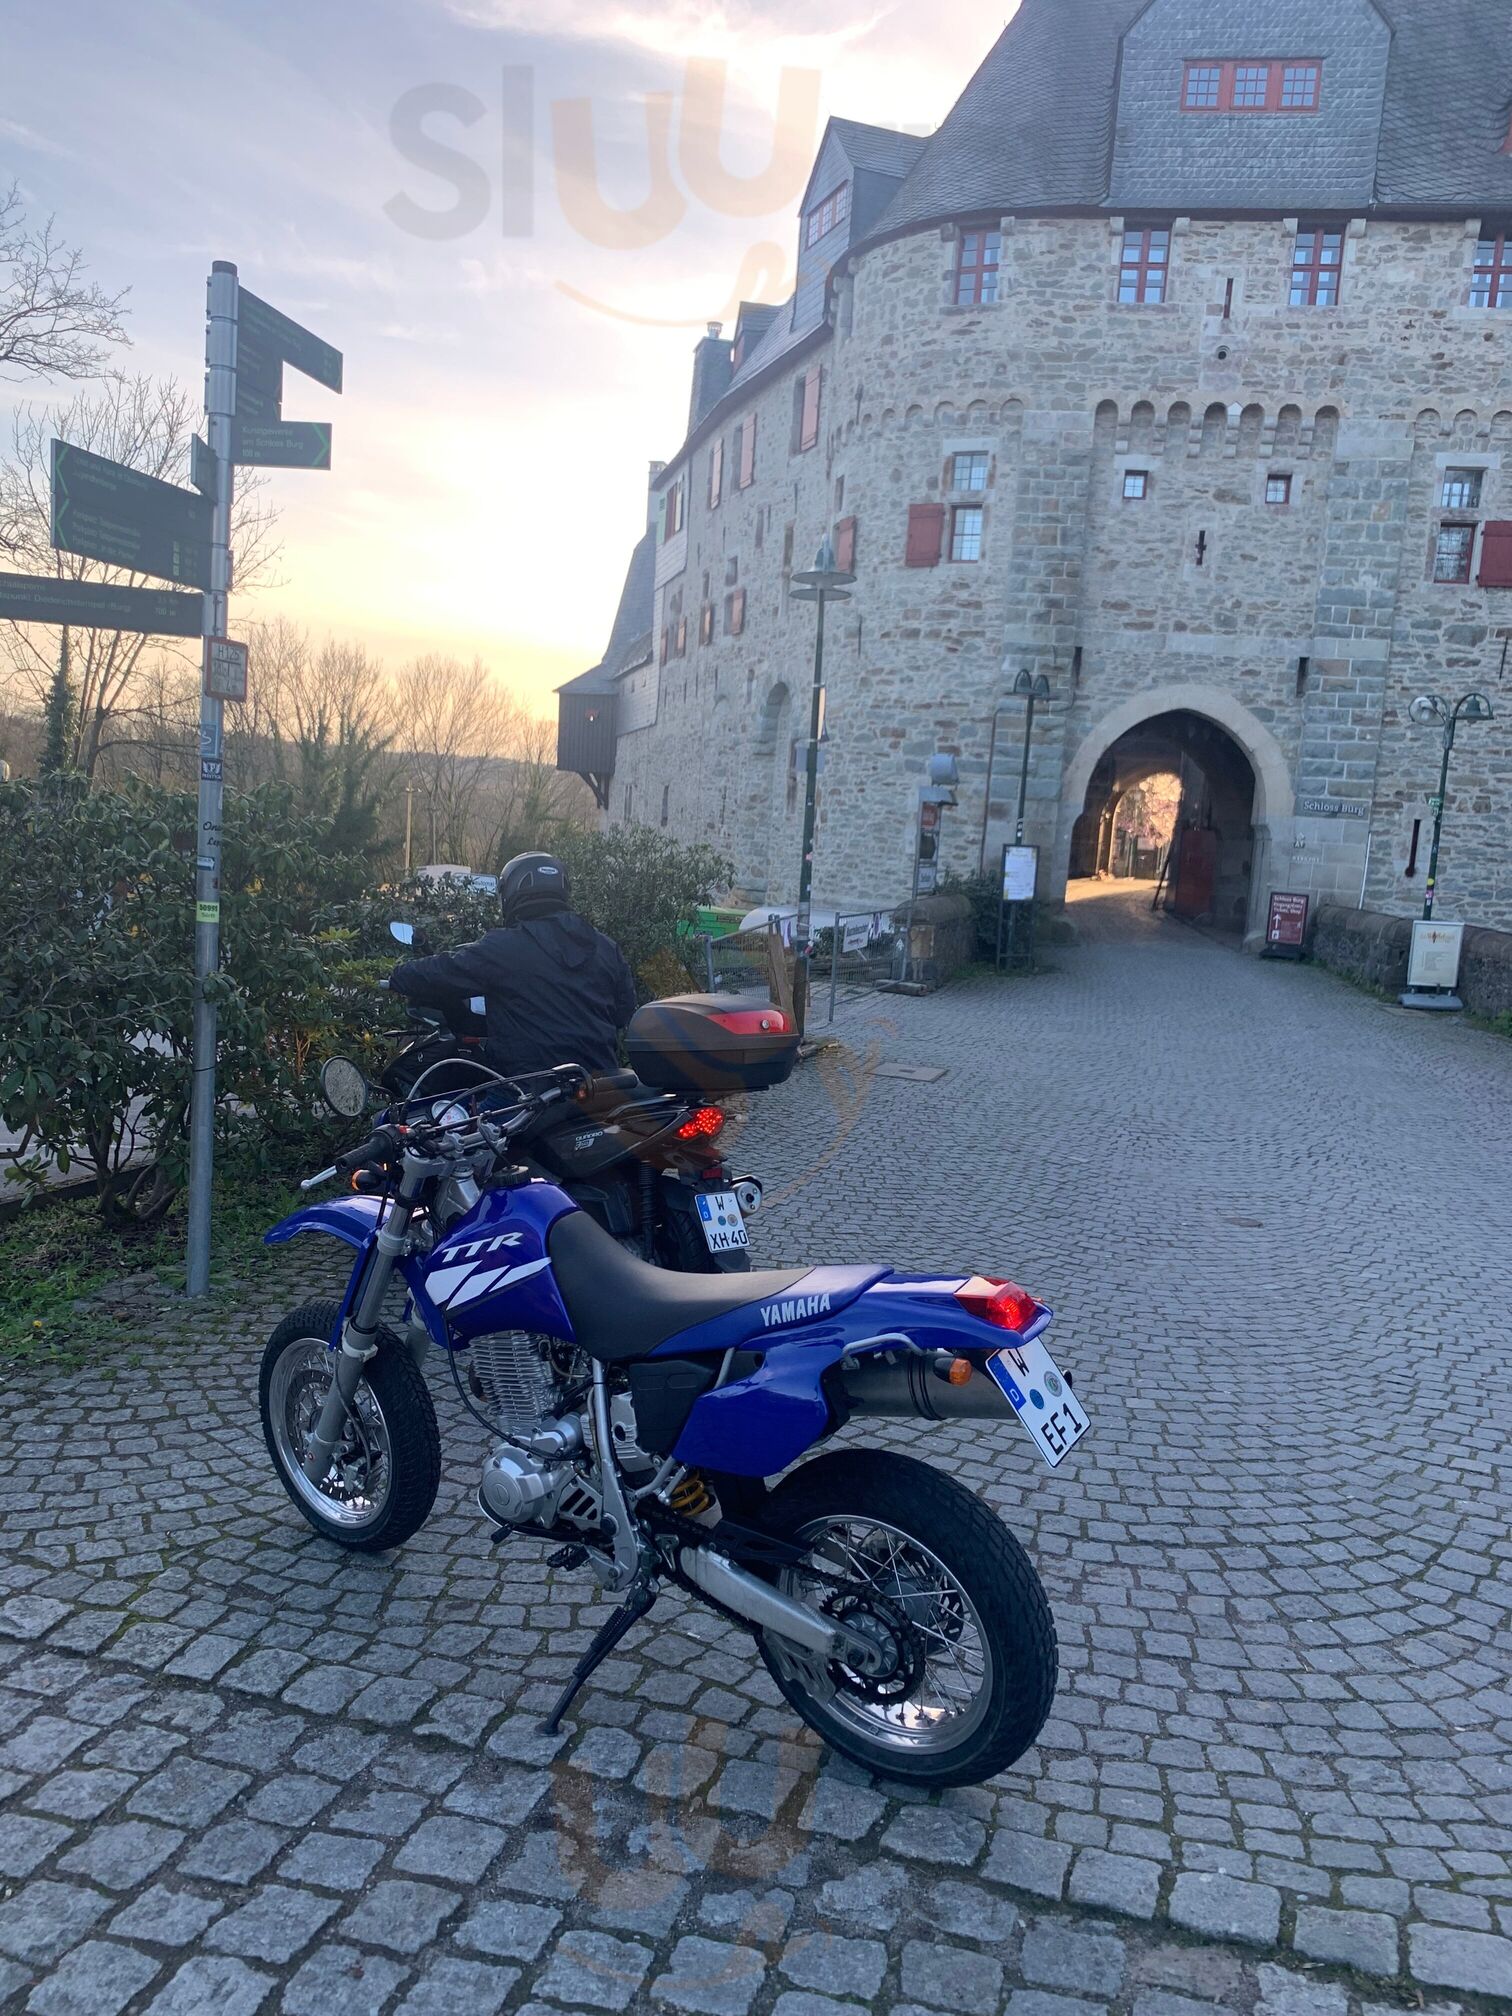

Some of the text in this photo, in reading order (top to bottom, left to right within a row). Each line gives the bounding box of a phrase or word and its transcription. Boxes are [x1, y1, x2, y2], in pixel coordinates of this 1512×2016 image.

[1304, 800, 1339, 812] Schloss
[714, 1196, 725, 1211] W
[441, 1231, 524, 1263] TTR
[760, 1293, 831, 1327] YAMAHA
[1008, 1346, 1030, 1377] W
[1009, 1388, 1020, 1402] D
